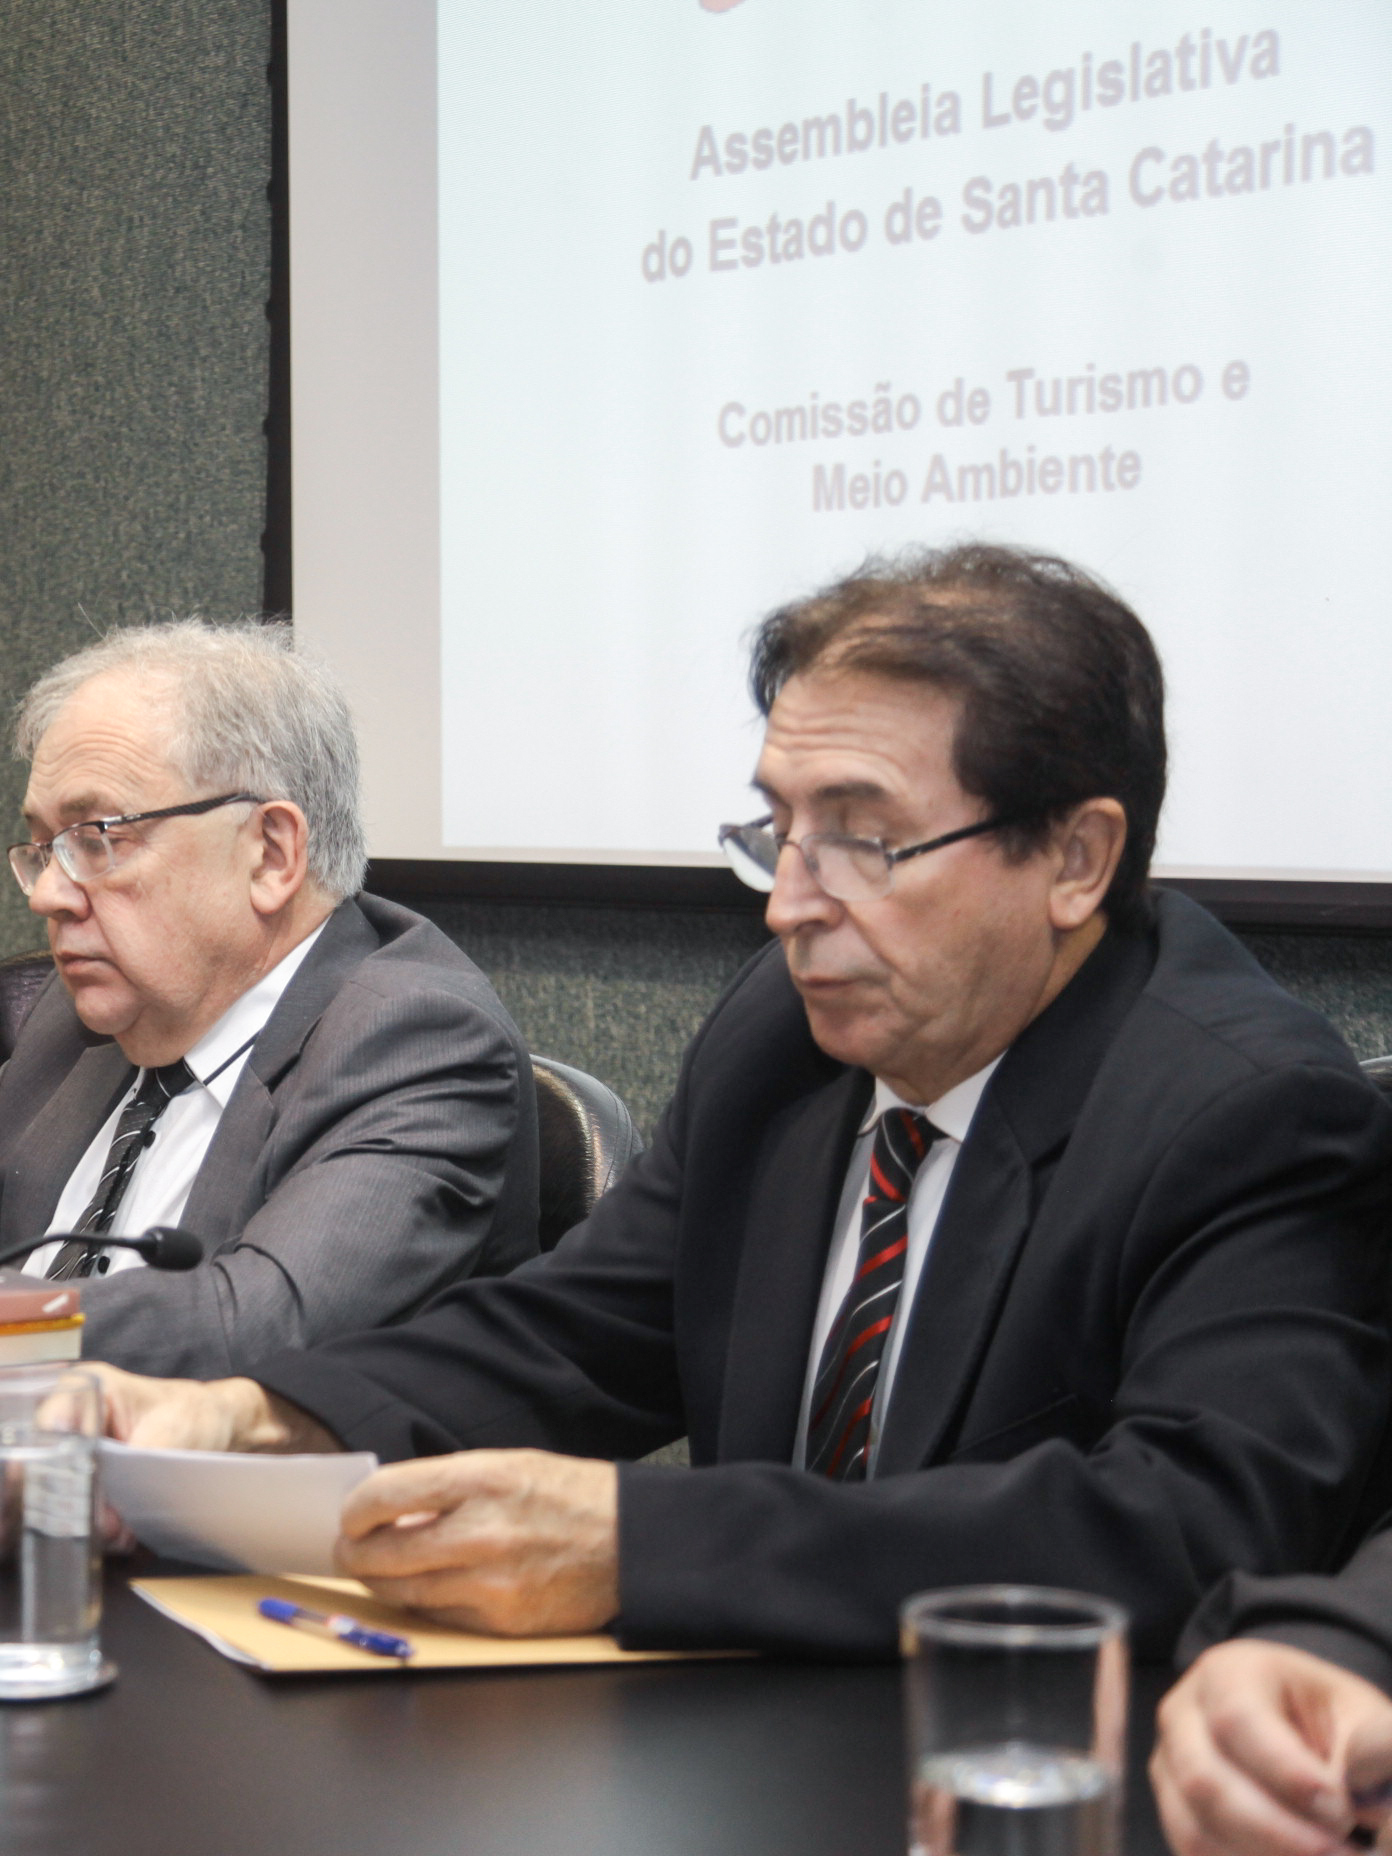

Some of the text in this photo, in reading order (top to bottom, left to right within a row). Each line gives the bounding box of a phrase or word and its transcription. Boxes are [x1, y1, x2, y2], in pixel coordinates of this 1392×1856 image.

[690, 28, 1280, 181] Assembleia Legislativa
[641, 123, 1374, 283] do Estado de Santa Catarina
[718, 360, 1250, 448] Comissão de Turismo e
[813, 445, 1142, 511] Meio Ambiente
